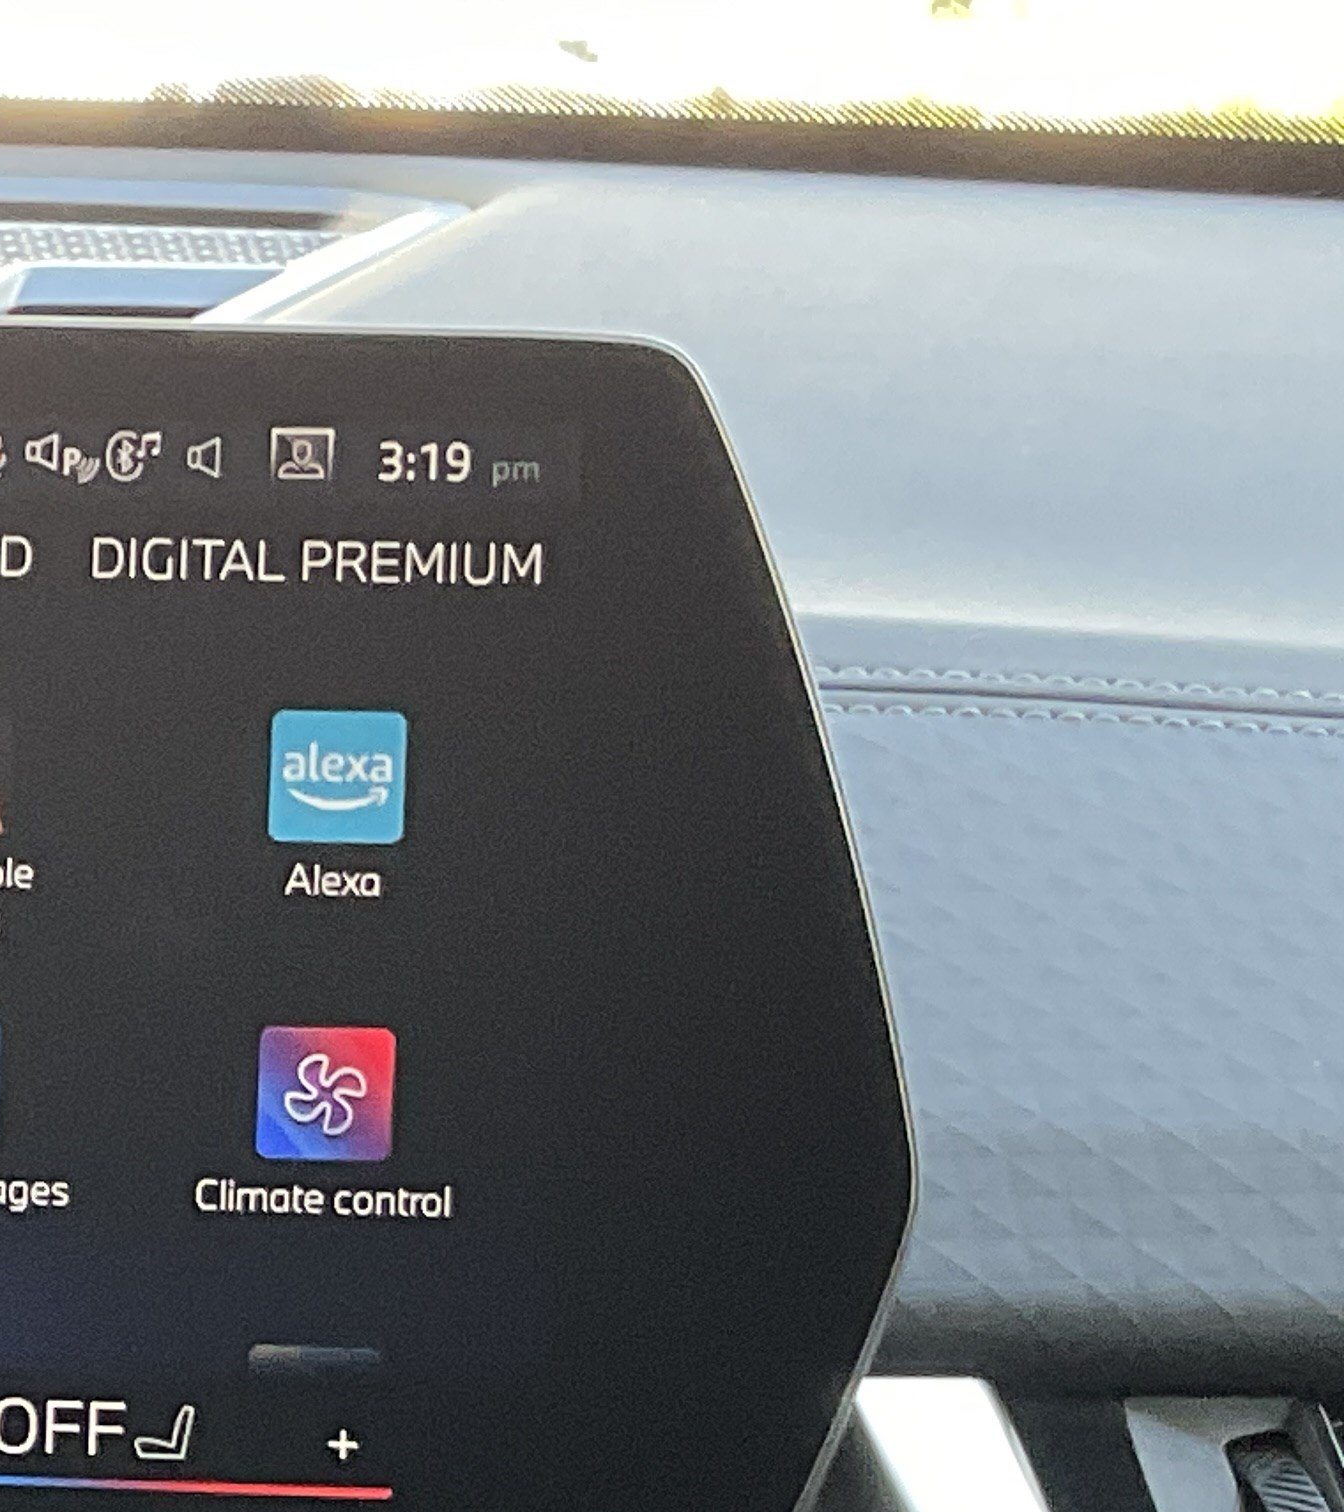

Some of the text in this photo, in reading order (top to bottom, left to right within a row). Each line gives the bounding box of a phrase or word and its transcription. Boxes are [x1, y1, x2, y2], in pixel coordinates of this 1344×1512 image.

[378, 440, 540, 488] 3:19 pm
[92, 536, 543, 586] DIGITAL PREMIUM
[282, 740, 393, 783] alexa
[284, 862, 381, 897] Alexa
[195, 1178, 452, 1218] Climate control
